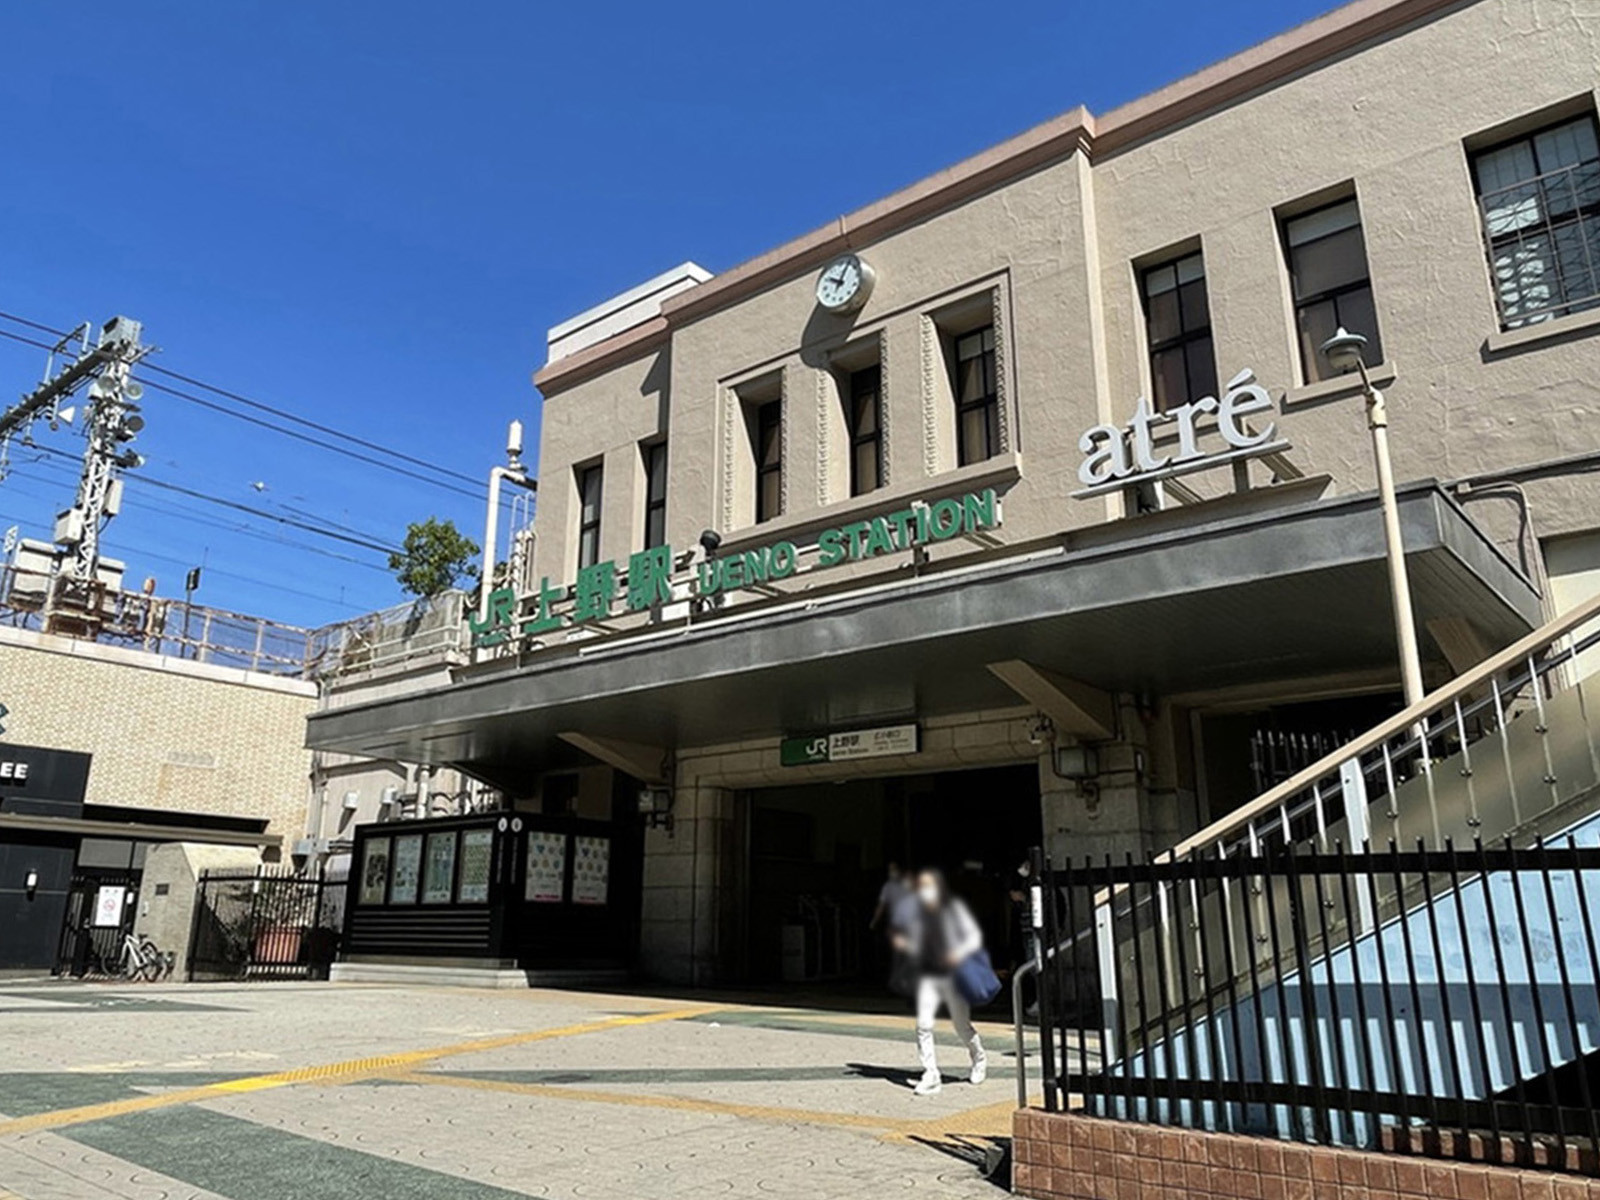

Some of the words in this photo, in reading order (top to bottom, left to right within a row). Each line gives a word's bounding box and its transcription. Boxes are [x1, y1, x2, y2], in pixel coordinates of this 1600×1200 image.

[1078, 367, 1275, 485] atré
[469, 587, 515, 634] JR
[523, 544, 671, 634] 上野駅
[698, 540, 797, 595] UENO
[817, 488, 997, 566] STATION
[805, 738, 828, 755] JR
